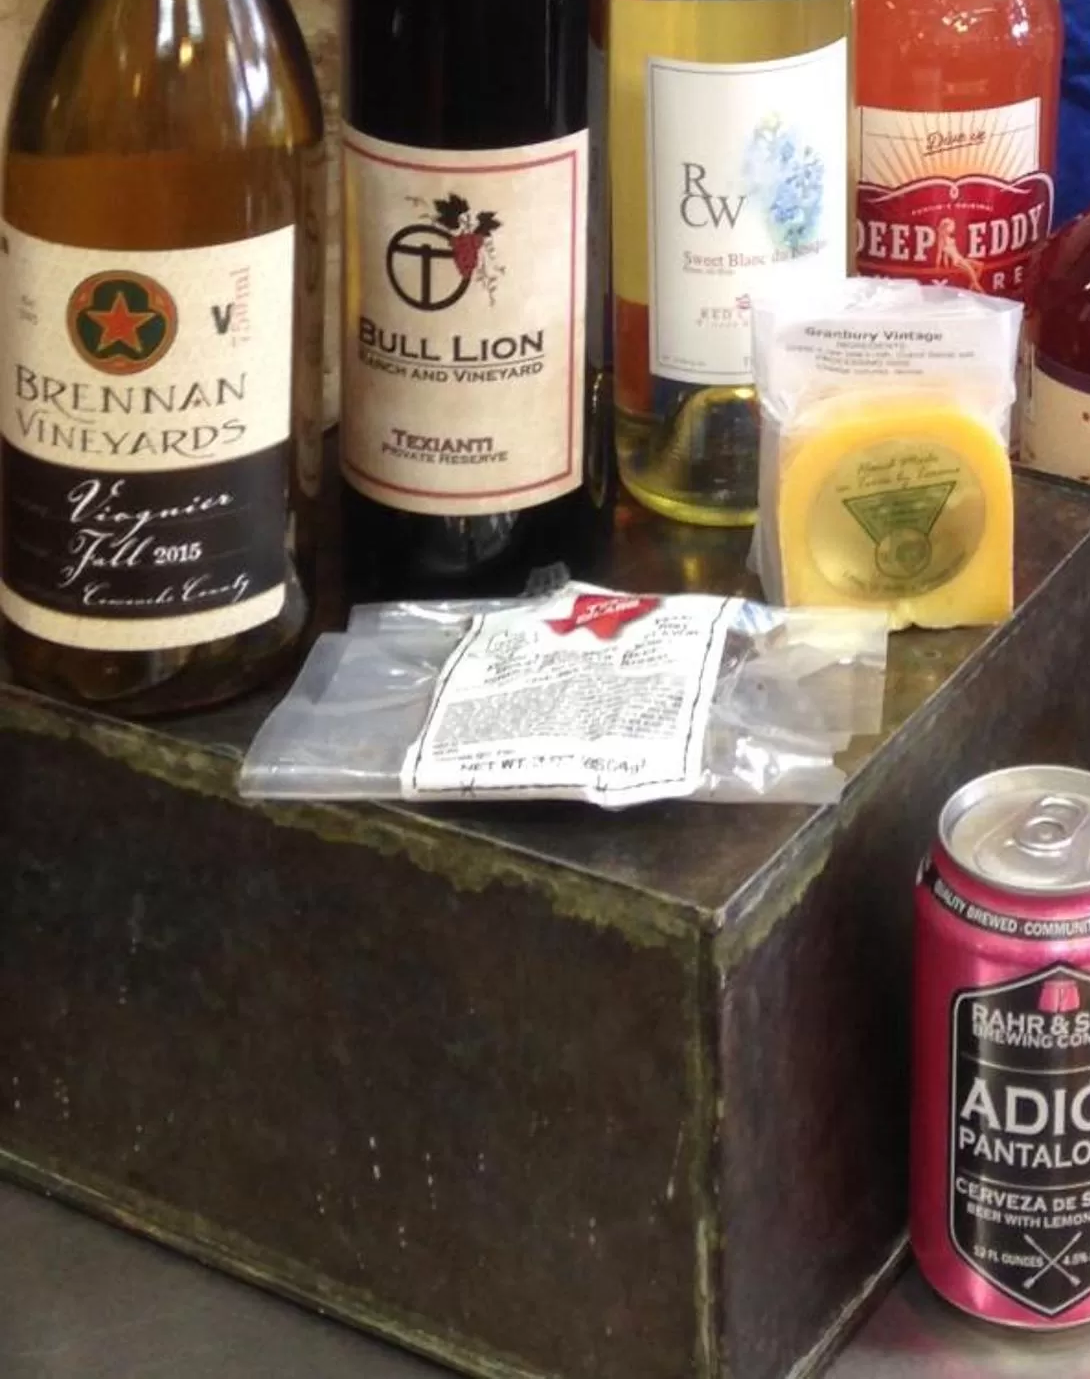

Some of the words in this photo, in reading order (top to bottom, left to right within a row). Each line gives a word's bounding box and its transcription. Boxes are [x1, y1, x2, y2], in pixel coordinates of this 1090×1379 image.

[968, 202, 1045, 259] EDDY
[358, 317, 440, 363] BULL
[452, 329, 545, 363] LION
[410, 367, 449, 384] AND
[452, 361, 545, 384] VINEYARD
[14, 364, 248, 425] BRENNAN
[14, 409, 248, 459] VINEYARDS
[153, 541, 202, 566] 2015
[933, 879, 966, 914] QUALITY
[966, 904, 1018, 933] BREWED
[971, 1002, 1045, 1035] RAHR
[1050, 1017, 1070, 1036] &
[972, 1021, 1052, 1049] BREWING
[955, 1177, 1048, 1213] CERVEZA
[1052, 1197, 1077, 1212] DE
[966, 1201, 1001, 1222] BEER
[1004, 1213, 1042, 1228] WITH
[1001, 1251, 1046, 1268] OUNCES
